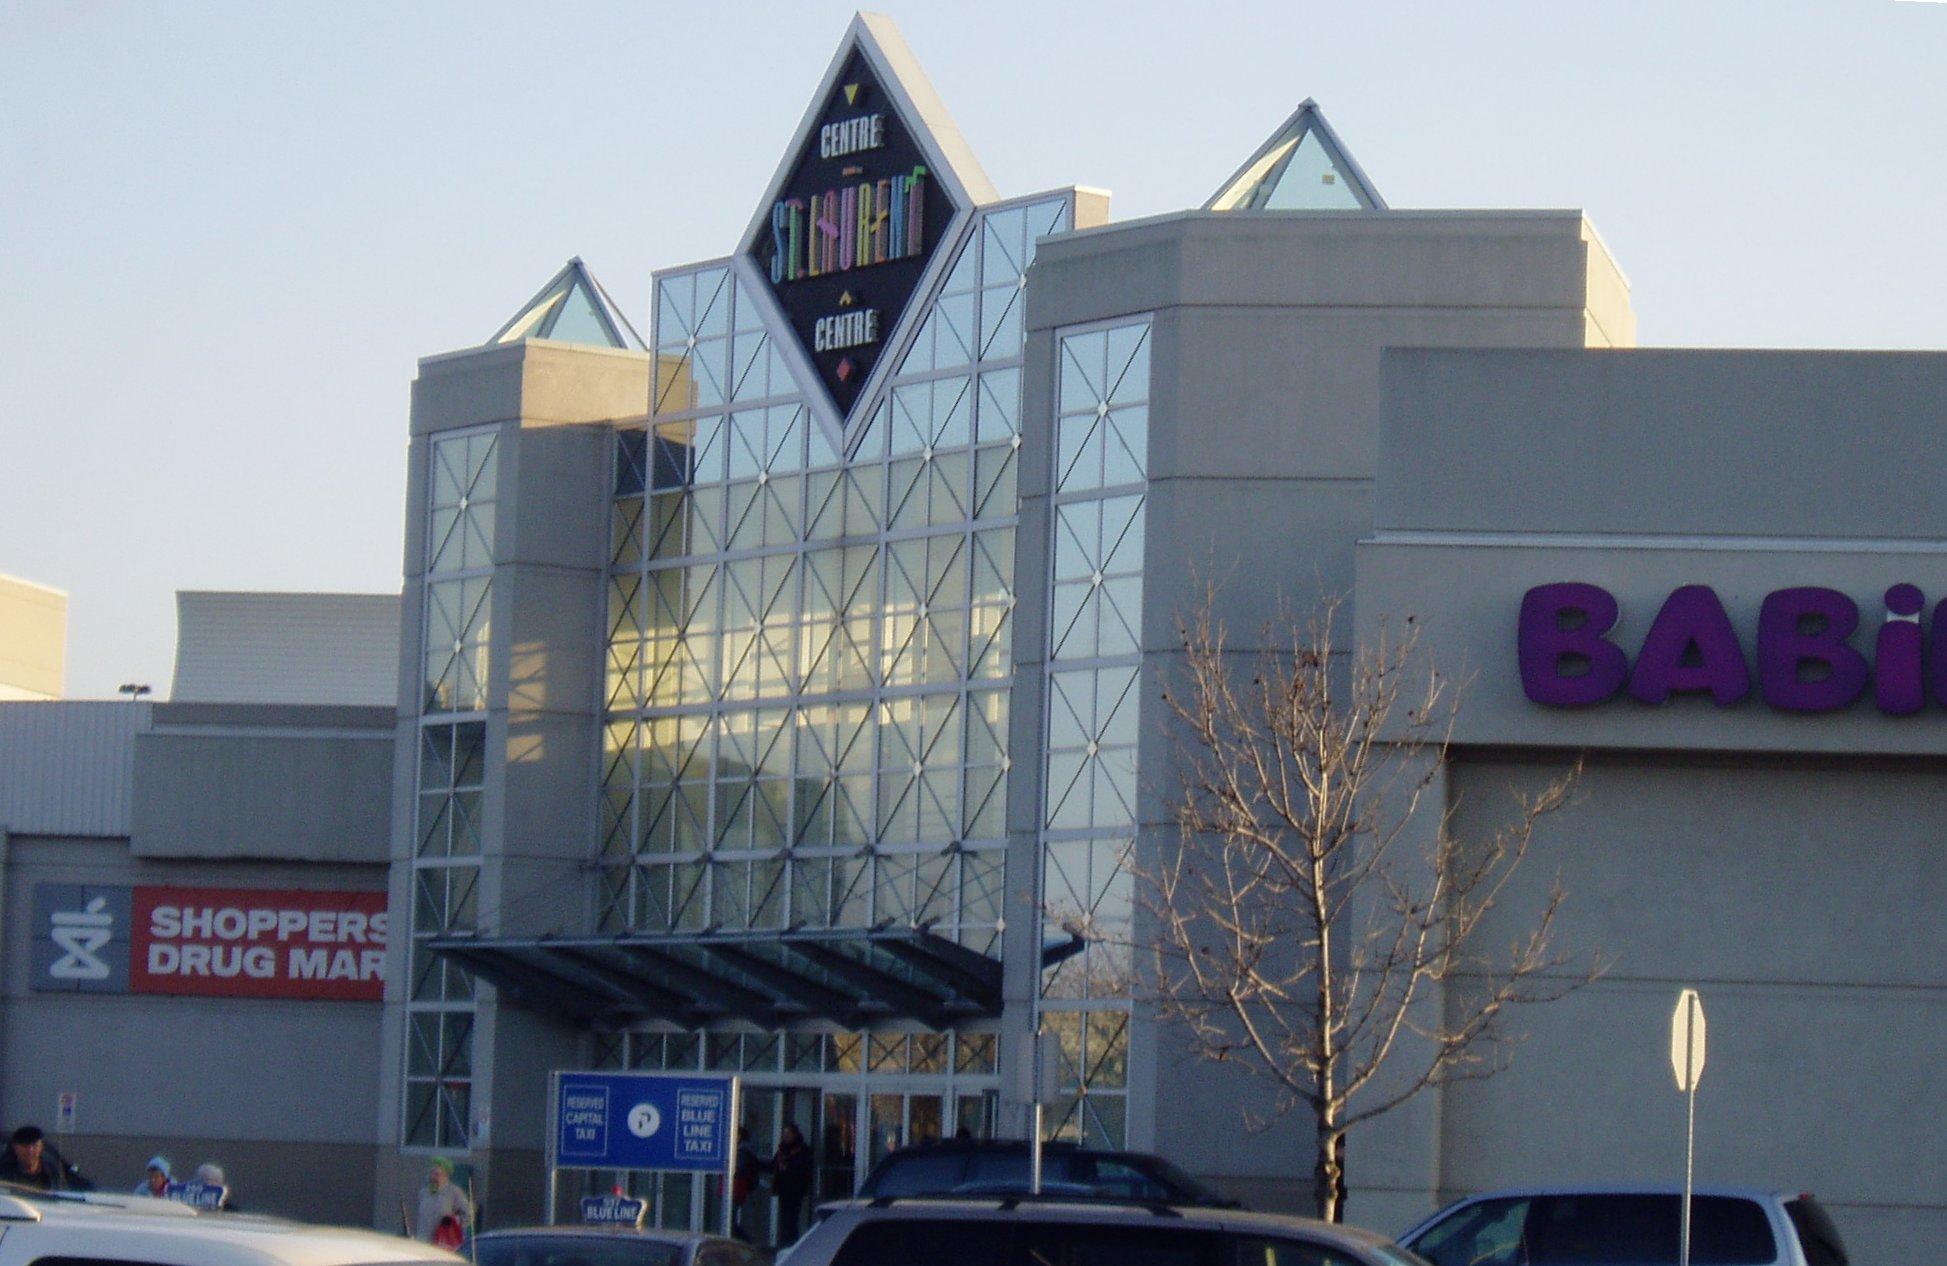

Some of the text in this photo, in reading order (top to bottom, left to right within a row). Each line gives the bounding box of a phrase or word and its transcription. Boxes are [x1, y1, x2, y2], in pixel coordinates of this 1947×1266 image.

[821, 114, 881, 159] CENTRE
[809, 166, 927, 276] LAURENT
[815, 309, 876, 351] CENTRE
[1518, 582, 1947, 716] BABi
[147, 943, 276, 978] DRUG
[566, 1112, 603, 1125] CAPITAL
[682, 1109, 715, 1122] BLUE
[576, 1128, 596, 1140] TAXI
[684, 1124, 712, 1137] LINE
[684, 1139, 711, 1152] TAXI
[587, 1206, 637, 1220] BLUE LINE
